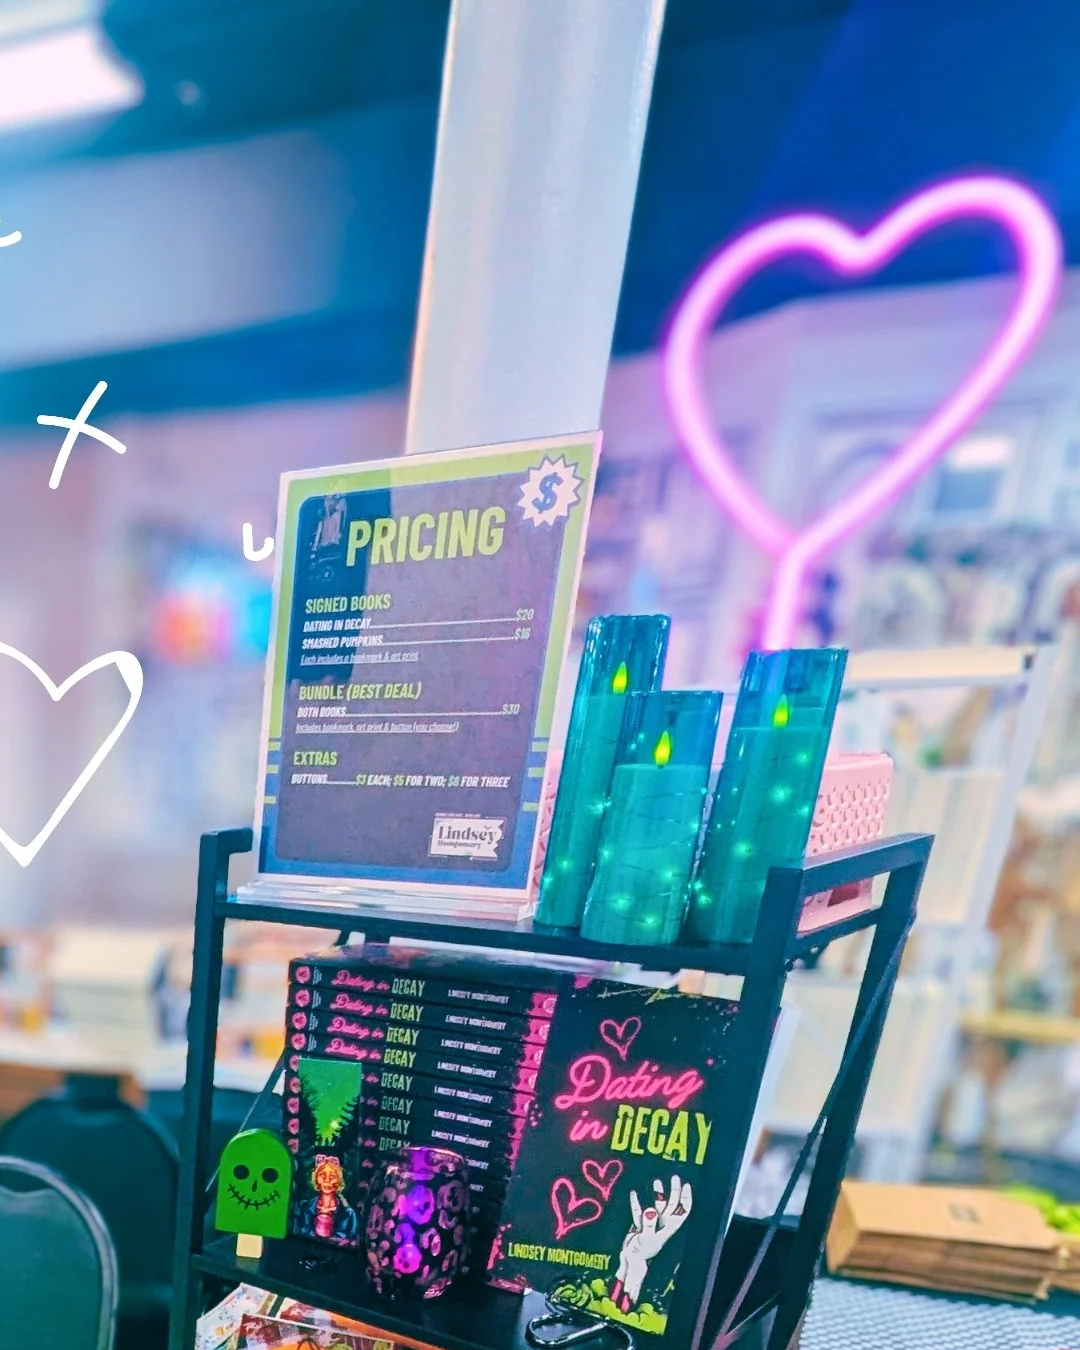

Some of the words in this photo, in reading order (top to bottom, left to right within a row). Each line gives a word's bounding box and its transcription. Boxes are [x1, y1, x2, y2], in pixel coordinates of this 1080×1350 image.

[532, 473, 563, 514] $
[346, 507, 507, 567] PRICING
[305, 597, 347, 614] SIGNED
[350, 594, 391, 612] BOOKS
[303, 618, 333, 632] DATING
[334, 618, 343, 631] IN
[302, 636, 339, 650] SMASHED
[299, 685, 344, 700] BUNDLE
[346, 684, 381, 701] (BEST
[384, 682, 422, 699] DEAL)
[297, 706, 318, 718] BOTH
[293, 751, 337, 766] EXTRAS
[367, 776, 393, 788] EACH;
[405, 777, 423, 787] FOR
[424, 776, 447, 788] TWO;
[461, 776, 480, 788] FOR
[480, 776, 511, 788] THREE
[438, 825, 497, 845] Lindsey
[331, 969, 375, 992] Dating
[392, 978, 426, 997] DECAY
[330, 992, 373, 1016] Dating
[390, 1003, 424, 1022] DECAY
[327, 1016, 370, 1040] Dating
[386, 1026, 420, 1046] DECAY
[325, 1037, 368, 1060] Dating
[383, 1048, 417, 1068] DECAY
[380, 1072, 413, 1092] DECAY
[554, 1052, 706, 1110] Dating
[381, 1096, 413, 1116] DECAY
[379, 1116, 410, 1135] DECAY
[570, 1109, 609, 1143] in
[611, 1104, 713, 1165] DECAY
[507, 1243, 547, 1263] LINDSEY
[547, 1246, 612, 1271] MONTGOMERY
